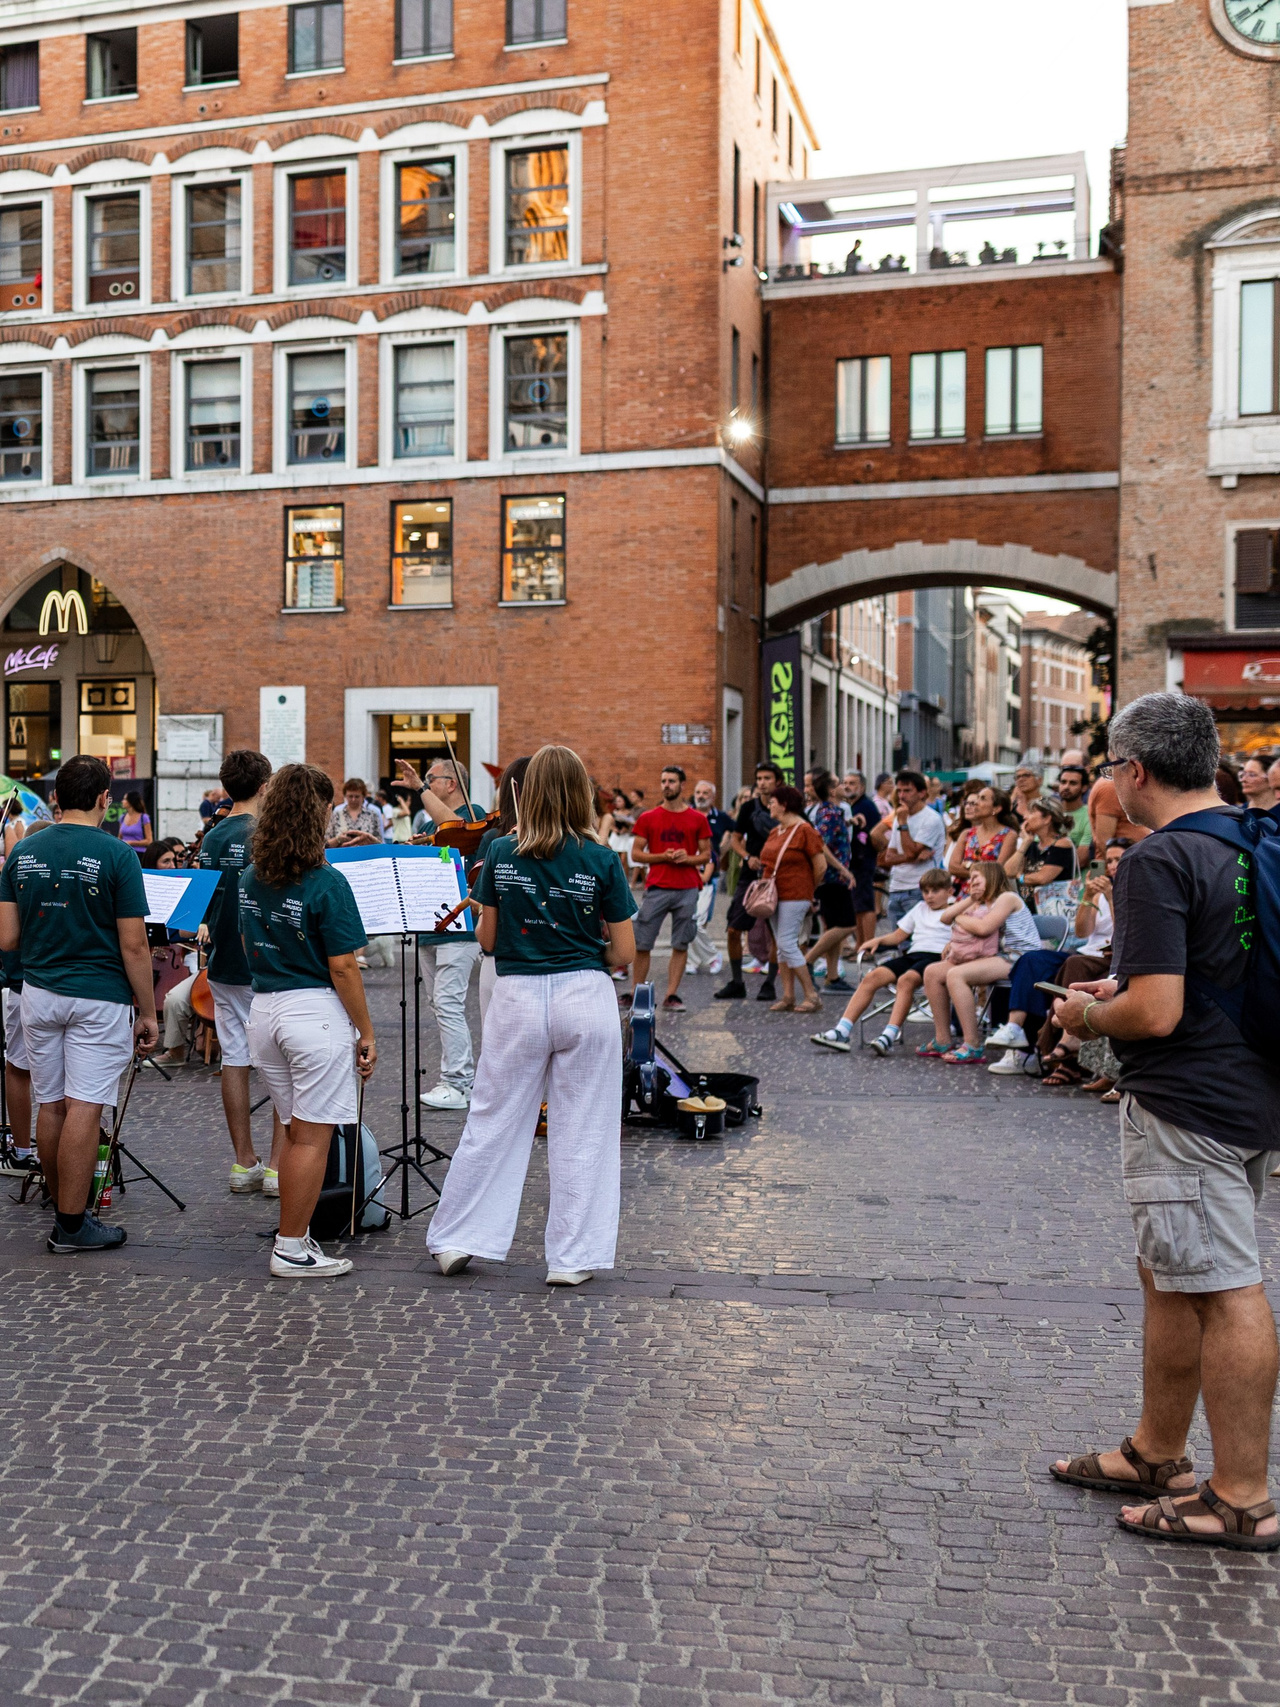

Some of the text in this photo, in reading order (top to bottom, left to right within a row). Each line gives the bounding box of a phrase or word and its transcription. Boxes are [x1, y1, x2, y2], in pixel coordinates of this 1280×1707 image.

[82, 856, 101, 865] SCUOLA
[574, 873, 596, 881] SCUOLA
[575, 879, 596, 887] MUSICA
